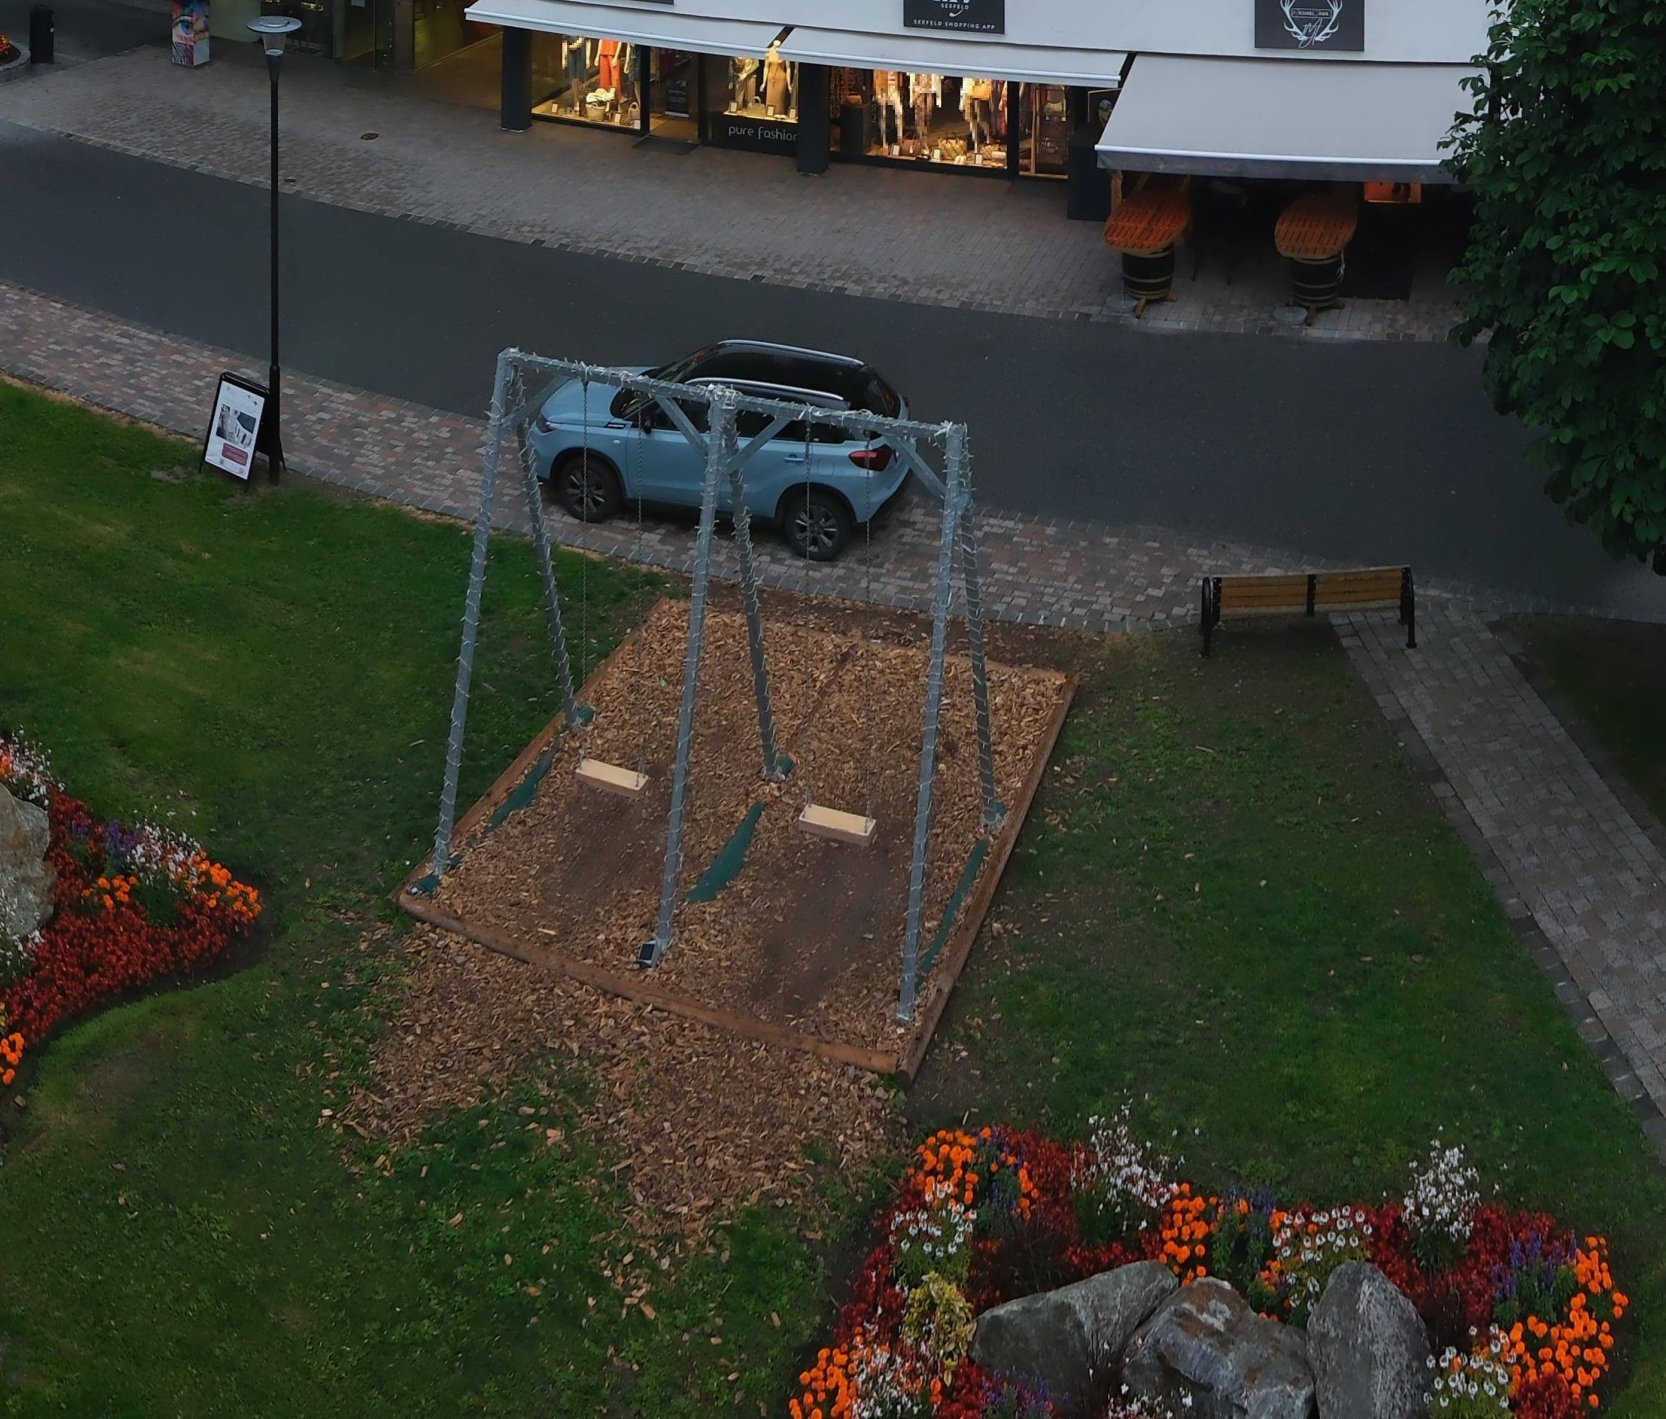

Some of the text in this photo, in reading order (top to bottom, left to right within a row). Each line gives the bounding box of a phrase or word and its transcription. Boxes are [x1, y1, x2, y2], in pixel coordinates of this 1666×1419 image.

[913, 19, 943, 27] SEEFELD
[945, 21, 980, 29] SHOPPING
[728, 126, 755, 137] pure
